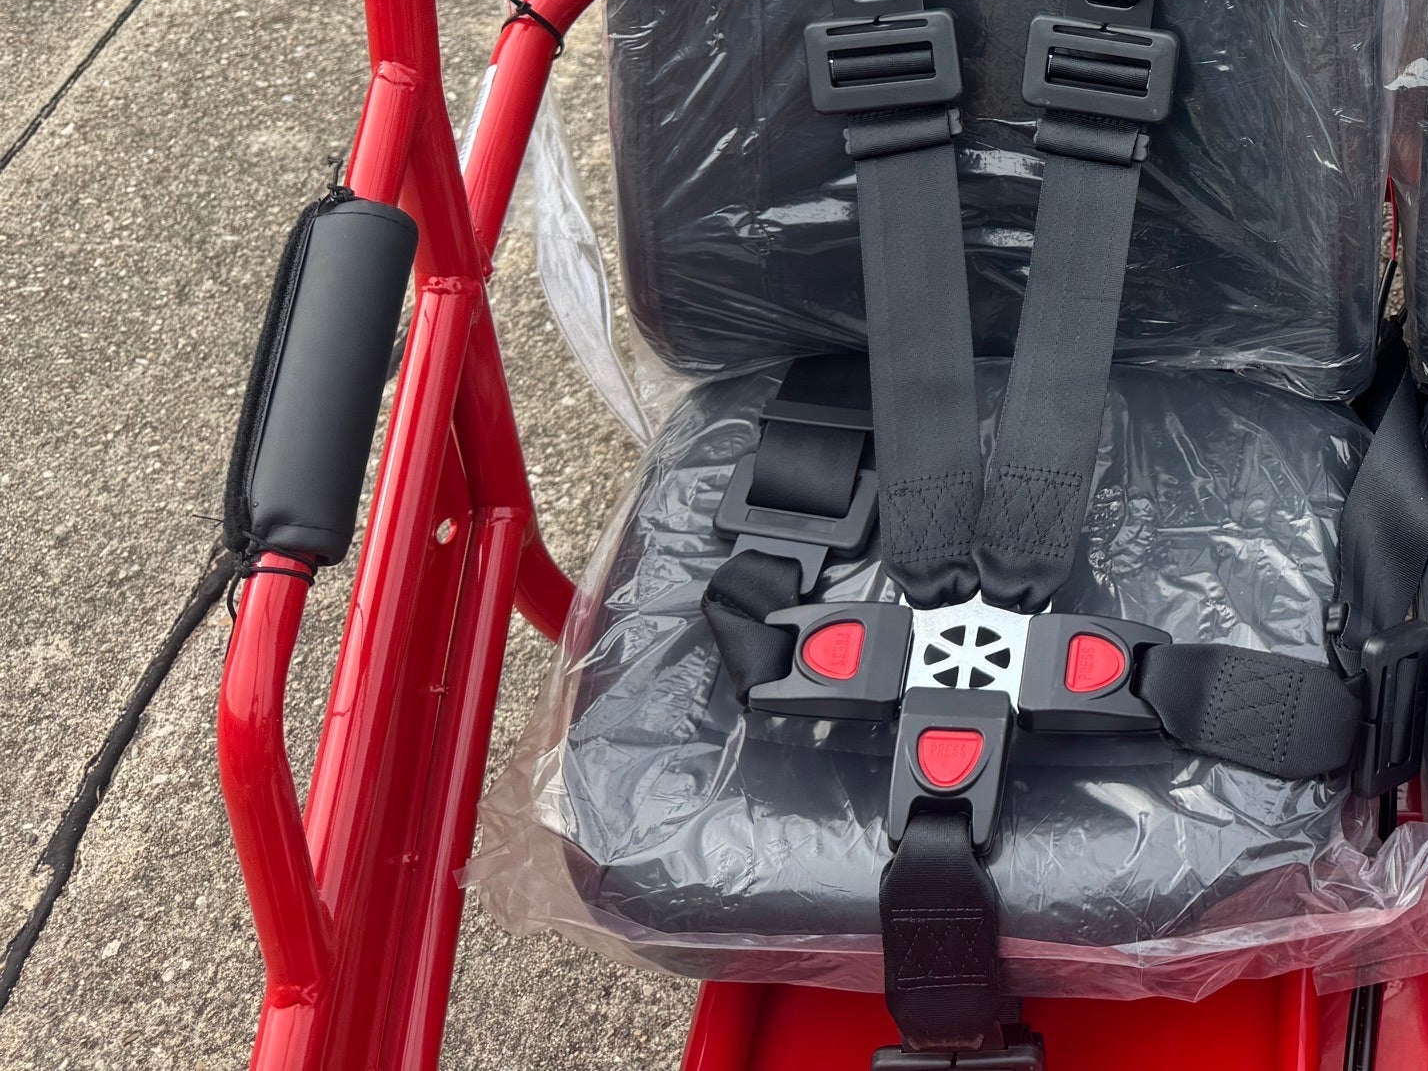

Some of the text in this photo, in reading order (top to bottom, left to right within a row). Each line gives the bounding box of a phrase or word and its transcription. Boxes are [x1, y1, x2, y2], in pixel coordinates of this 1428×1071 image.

[831, 632, 850, 666] PRESS
[1078, 647, 1096, 681] PRESS
[930, 743, 967, 758] PRESS
